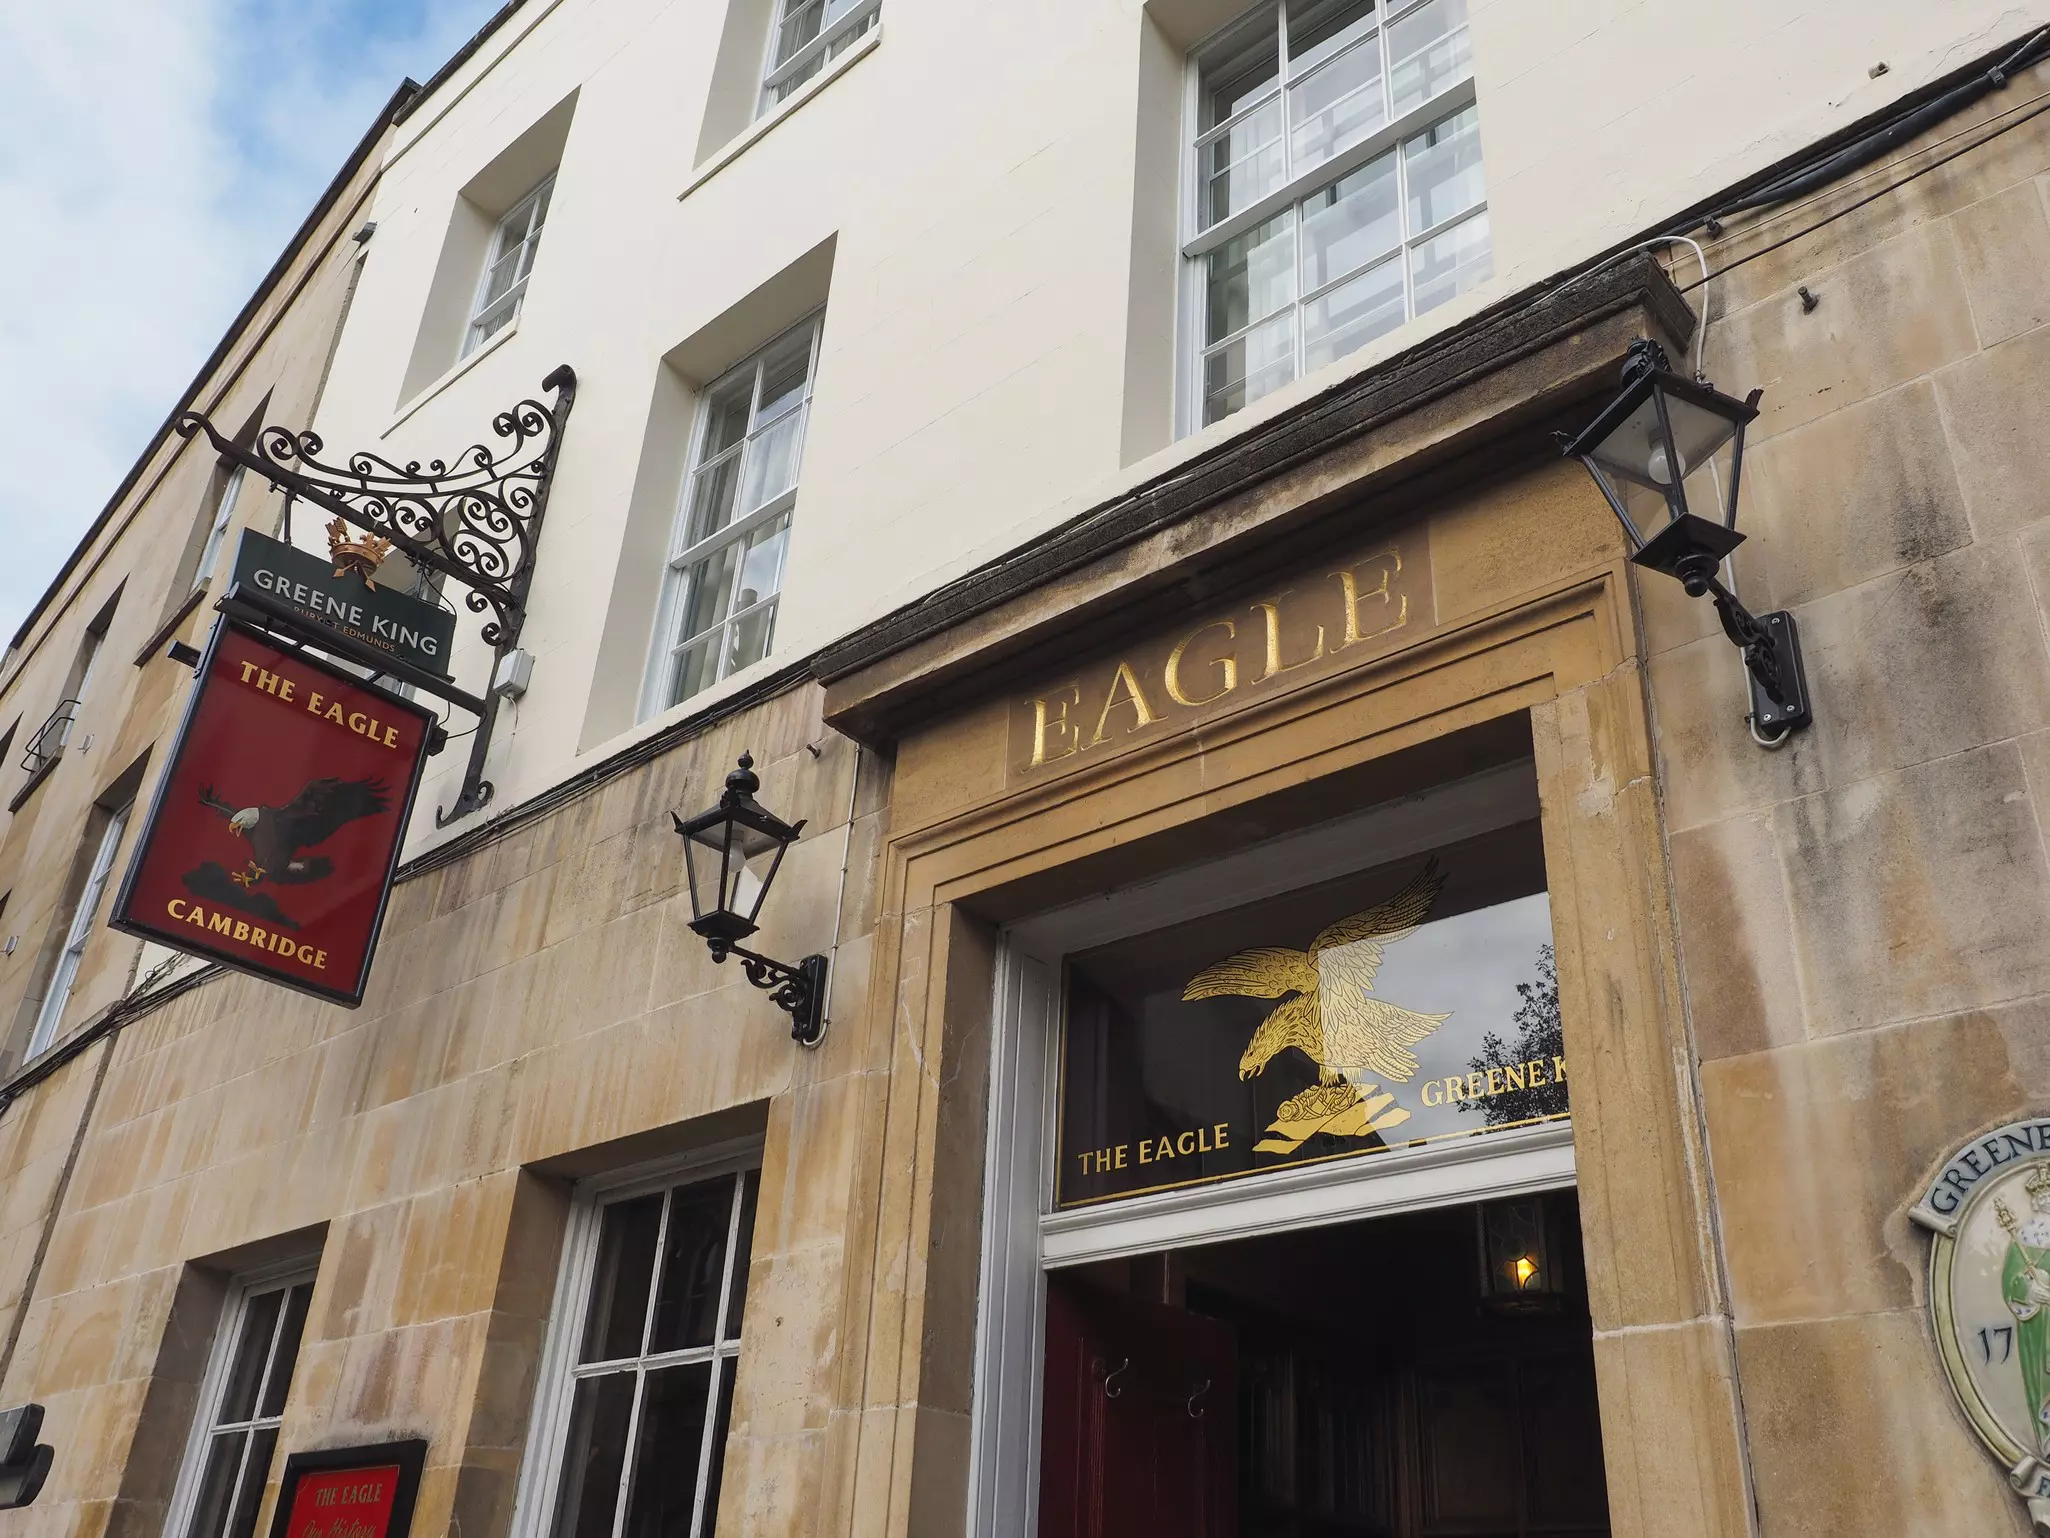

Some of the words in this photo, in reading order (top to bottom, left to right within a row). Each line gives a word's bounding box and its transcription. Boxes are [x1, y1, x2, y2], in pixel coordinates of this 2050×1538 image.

[253, 569, 363, 627] GREENE
[371, 615, 438, 656] KING
[343, 626, 395, 652] EDMUNDS
[1020, 548, 1407, 773] EAGLE
[239, 660, 295, 703] THE
[307, 693, 399, 749] EAGLE
[167, 898, 329, 970] CAMBRIDGE
[1421, 1059, 1546, 1107] GREENE
[1077, 1143, 1128, 1176] THE
[1139, 1123, 1230, 1165] EAGLE
[1977, 1326, 2013, 1366] 17
[315, 1487, 338, 1507] THE
[341, 1482, 383, 1505] EAGLE
